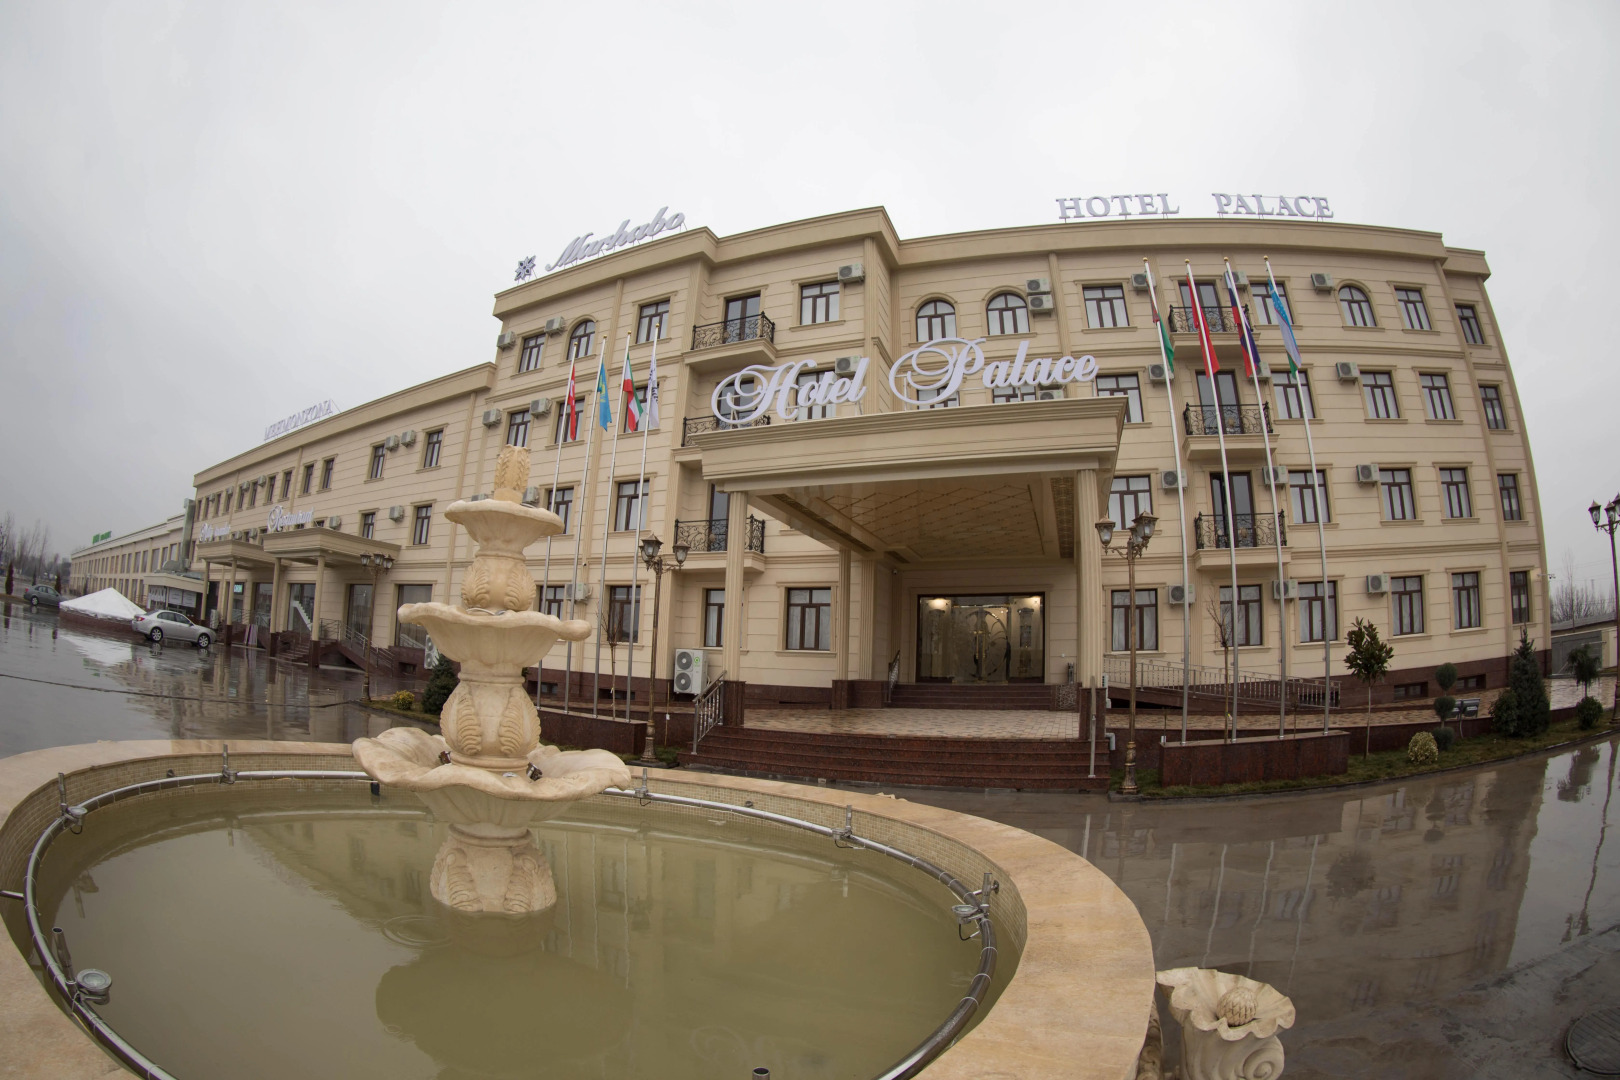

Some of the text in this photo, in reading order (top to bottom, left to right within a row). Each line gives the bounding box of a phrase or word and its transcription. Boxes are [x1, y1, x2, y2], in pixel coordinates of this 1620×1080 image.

[1056, 193, 1334, 218] HOTEL PALACE
[545, 206, 685, 271] Marhabo
[711, 356, 869, 424] Hotel
[888, 337, 1100, 405] Palace
